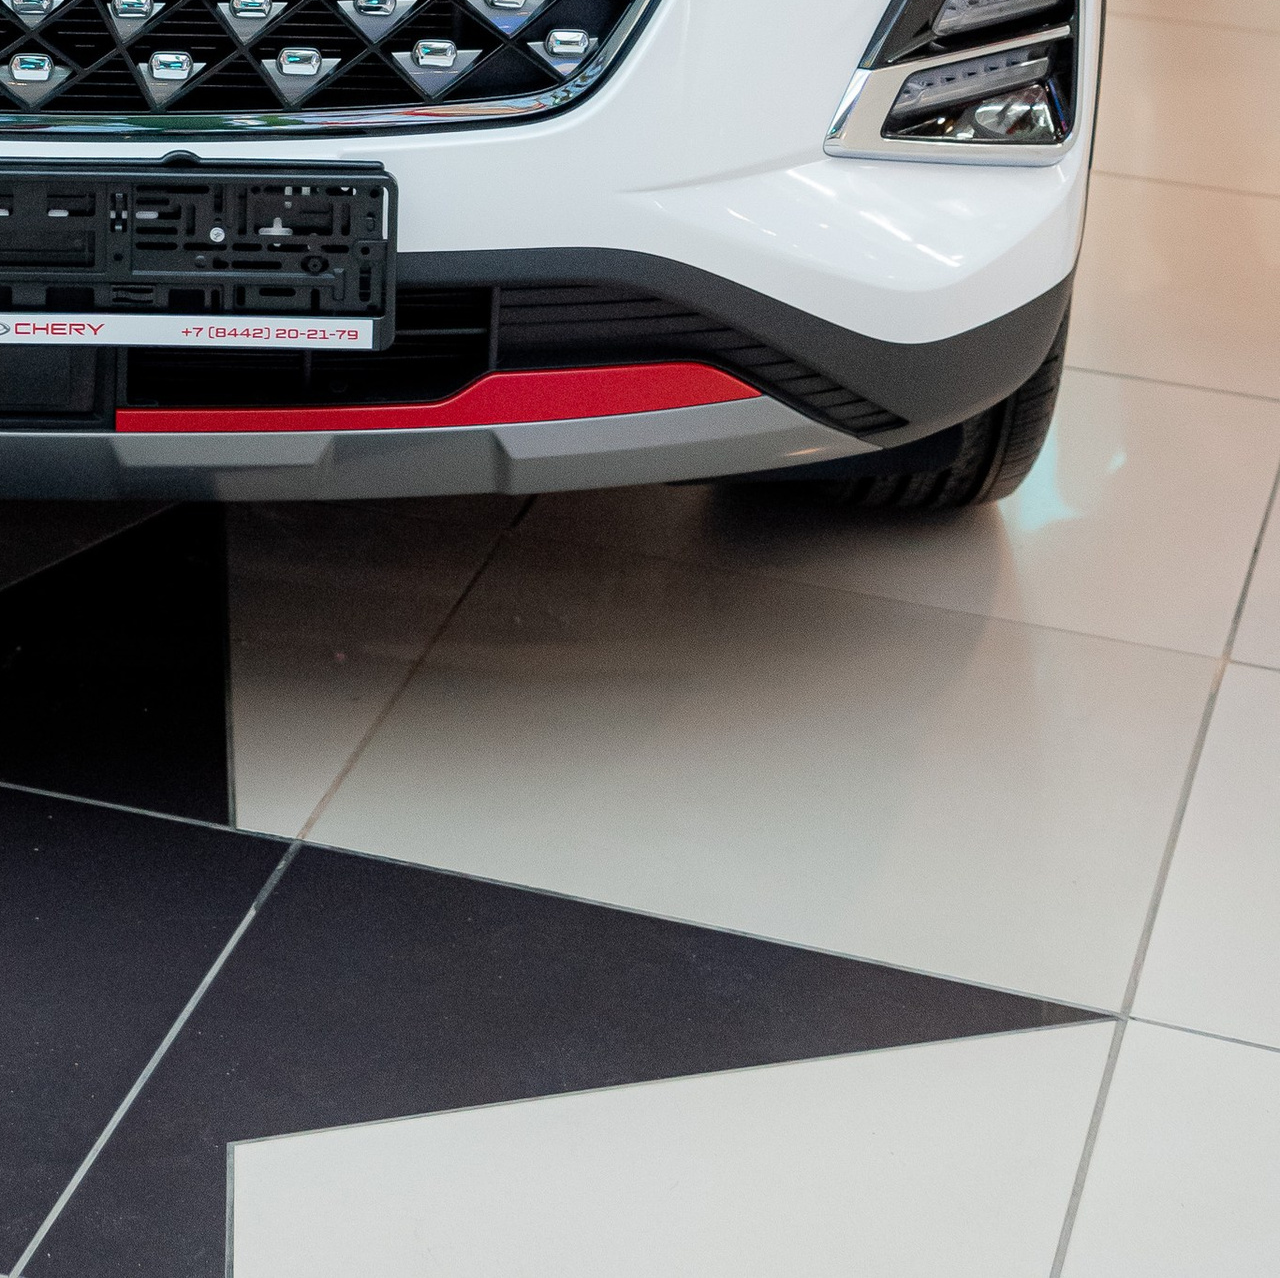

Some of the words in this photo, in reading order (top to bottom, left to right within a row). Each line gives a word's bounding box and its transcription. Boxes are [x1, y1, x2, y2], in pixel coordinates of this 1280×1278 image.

[14, 322, 105, 335] CHERY
[181, 327, 203, 338] +7
[275, 328, 359, 340] 20-21-79
